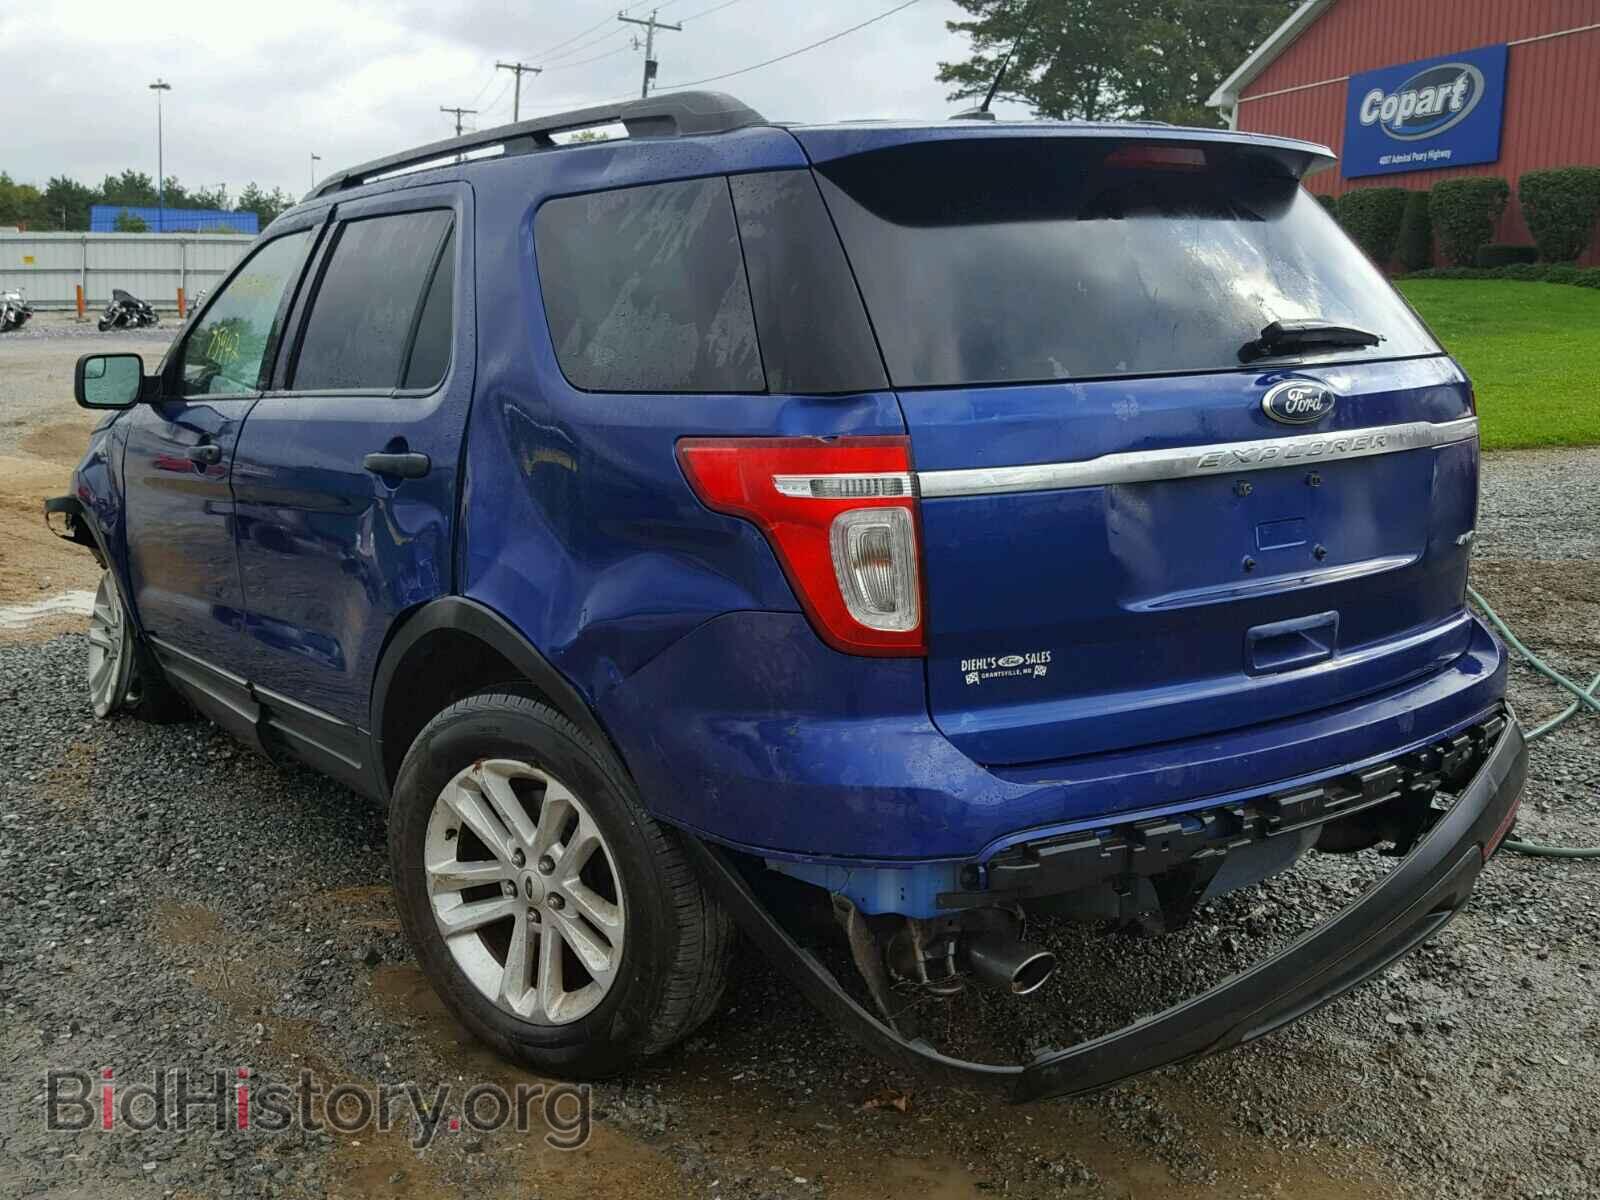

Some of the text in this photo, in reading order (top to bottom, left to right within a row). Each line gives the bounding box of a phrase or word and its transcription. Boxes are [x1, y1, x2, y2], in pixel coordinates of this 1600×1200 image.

[1360, 70, 1469, 129] Copart
[1428, 149, 1452, 161] Highway
[1285, 388, 1324, 414] Ford
[1197, 432, 1387, 469] EXPLORER
[961, 657, 997, 672] DIEHL'S
[1025, 650, 1052, 665] SALES
